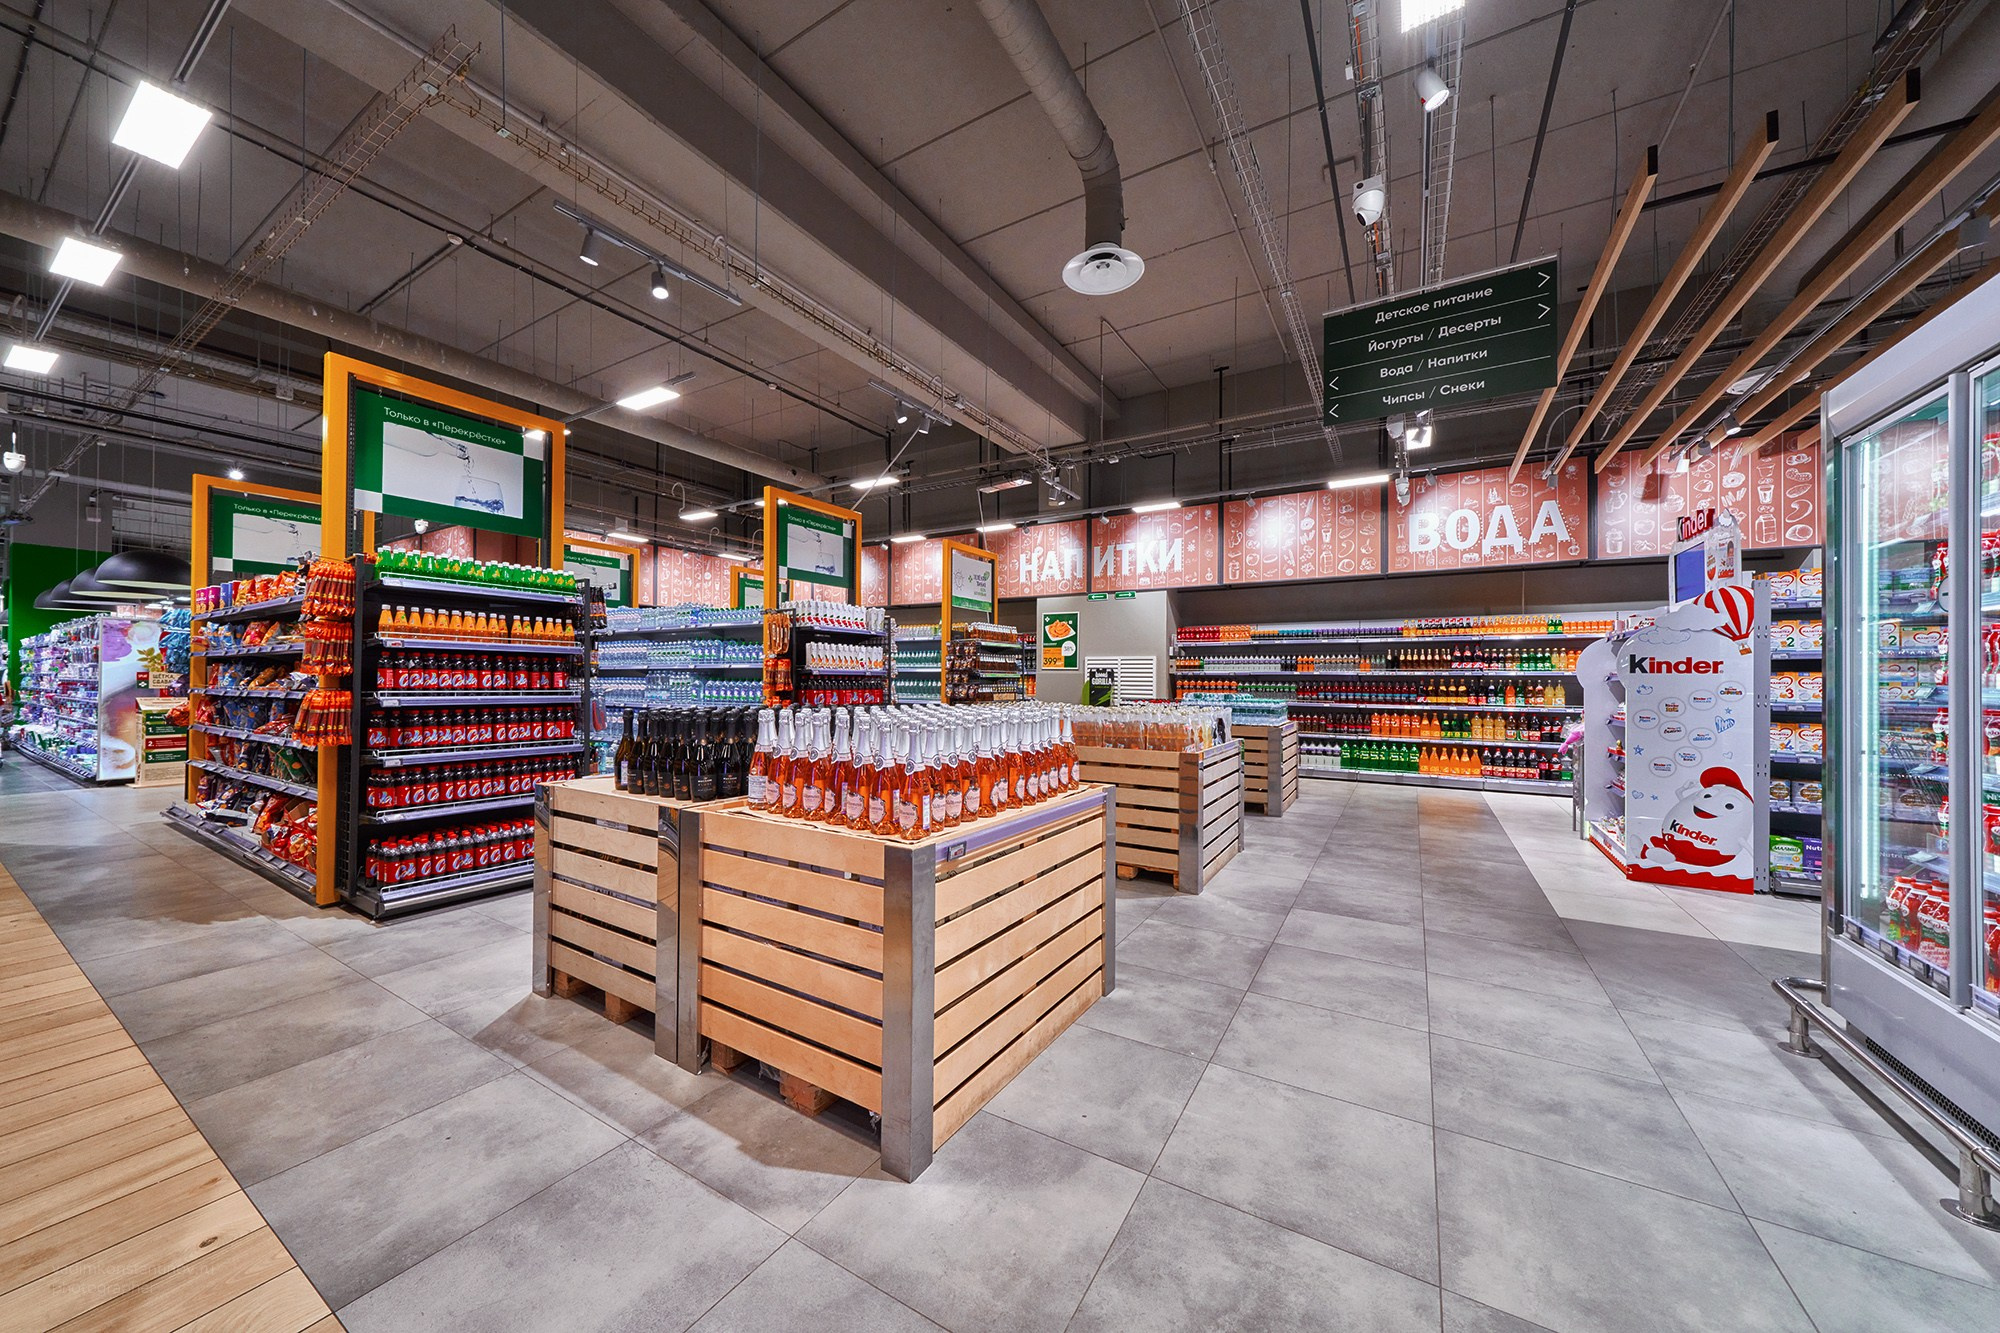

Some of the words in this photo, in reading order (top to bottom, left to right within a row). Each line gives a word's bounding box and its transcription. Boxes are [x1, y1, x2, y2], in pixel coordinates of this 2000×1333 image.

[1375, 303, 1430, 324] Детское
[1433, 287, 1493, 309] питание
[1368, 333, 1424, 353] Йогурты
[1438, 316, 1502, 339] Десерты
[1380, 364, 1413, 378] Вода
[1428, 350, 1488, 369] Напитки
[1382, 391, 1425, 405] Чипсы
[1440, 380, 1485, 395] Снеки
[383, 406, 421, 425] Только
[423, 418, 430, 427] в
[432, 421, 507, 445] «Перекрёстке»
[233, 503, 262, 513] Только
[269, 509, 322, 522] «Перекрёстке
[1677, 509, 1709, 541] Kinder
[1408, 500, 1571, 555] ВОДА
[1020, 538, 1184, 584] НАПИТКИ
[1786, 637, 1795, 647] 2
[1043, 657, 1057, 665] 399
[1629, 654, 1724, 674] Kinder
[1785, 688, 1794, 699] 3
[1669, 819, 1718, 846] Kinder
